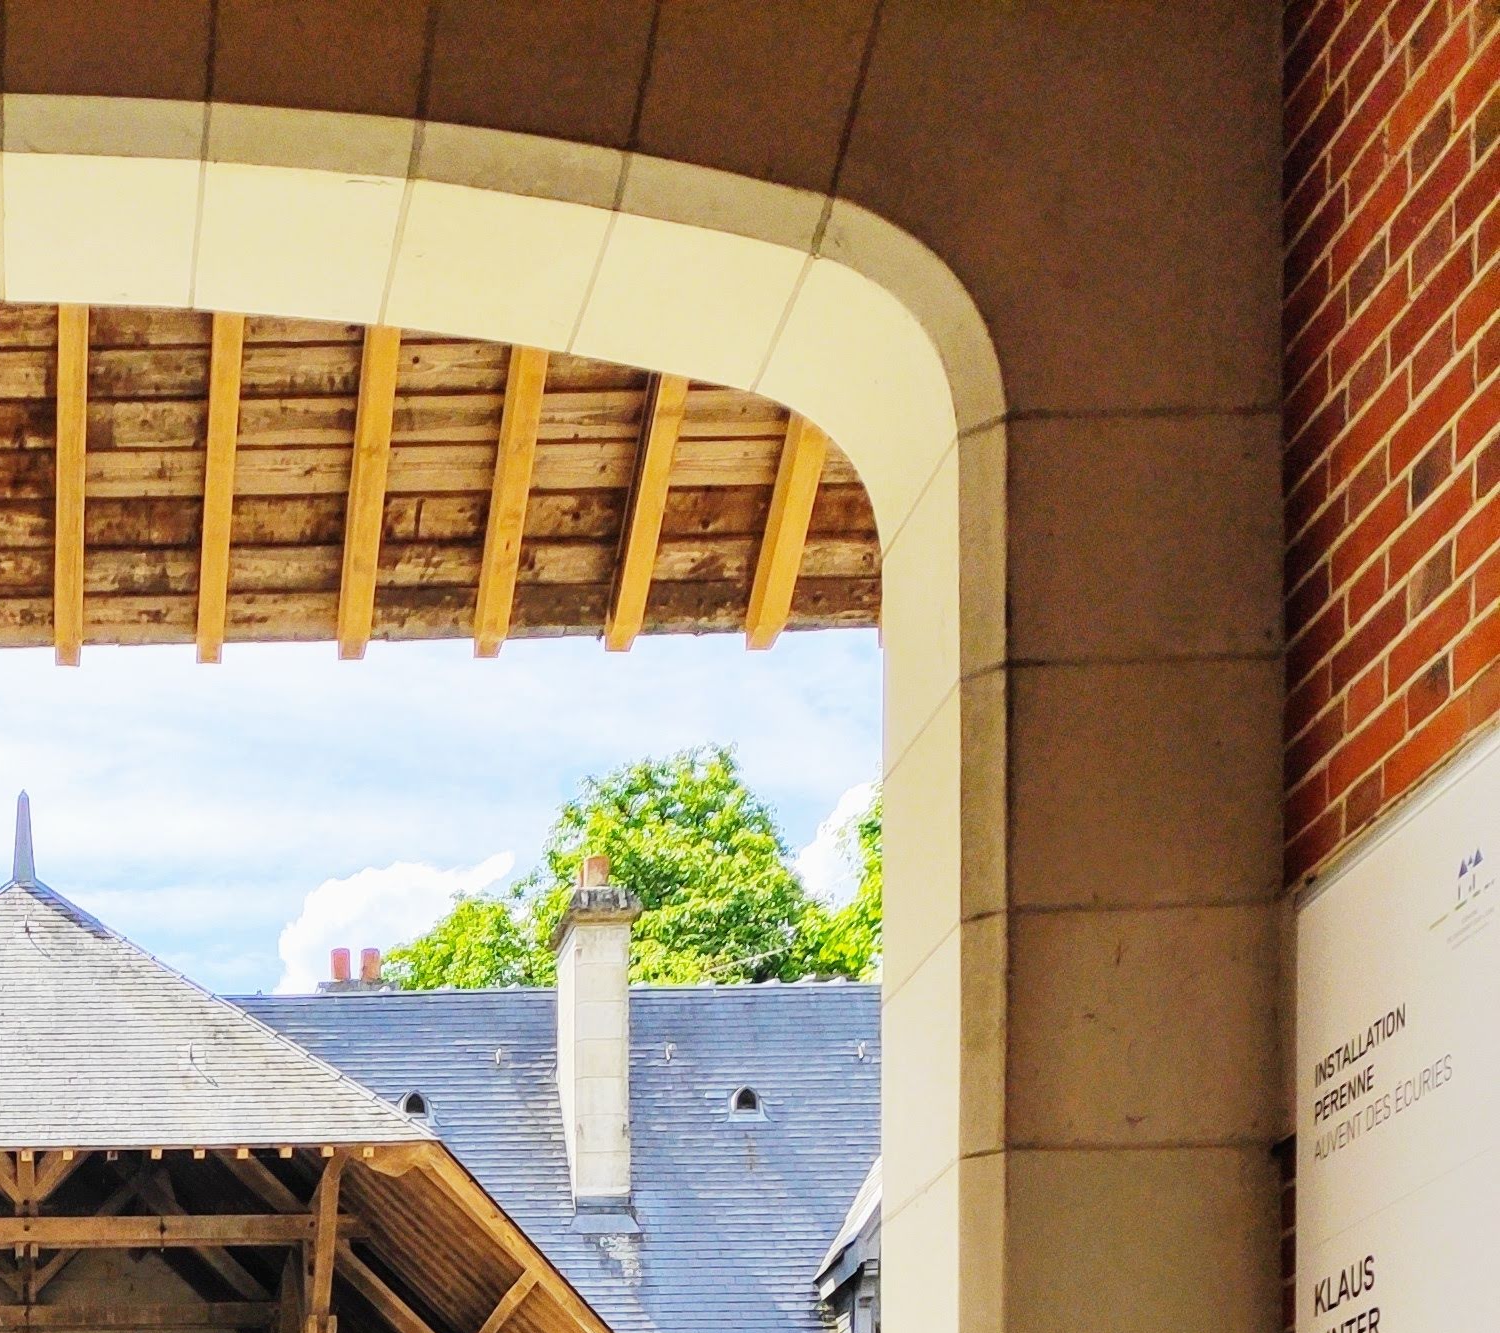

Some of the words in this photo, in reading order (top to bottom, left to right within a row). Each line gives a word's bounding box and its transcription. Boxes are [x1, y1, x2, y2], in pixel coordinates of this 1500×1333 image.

[1315, 1003, 1406, 1088] INSTALLATION
[1314, 1064, 1375, 1125] PÉRENNE
[1314, 1110, 1363, 1162] AUVENT
[1366, 1093, 1391, 1132] DES
[1395, 1054, 1453, 1113] ÉCURIES
[1314, 1255, 1375, 1317] KLAUS
